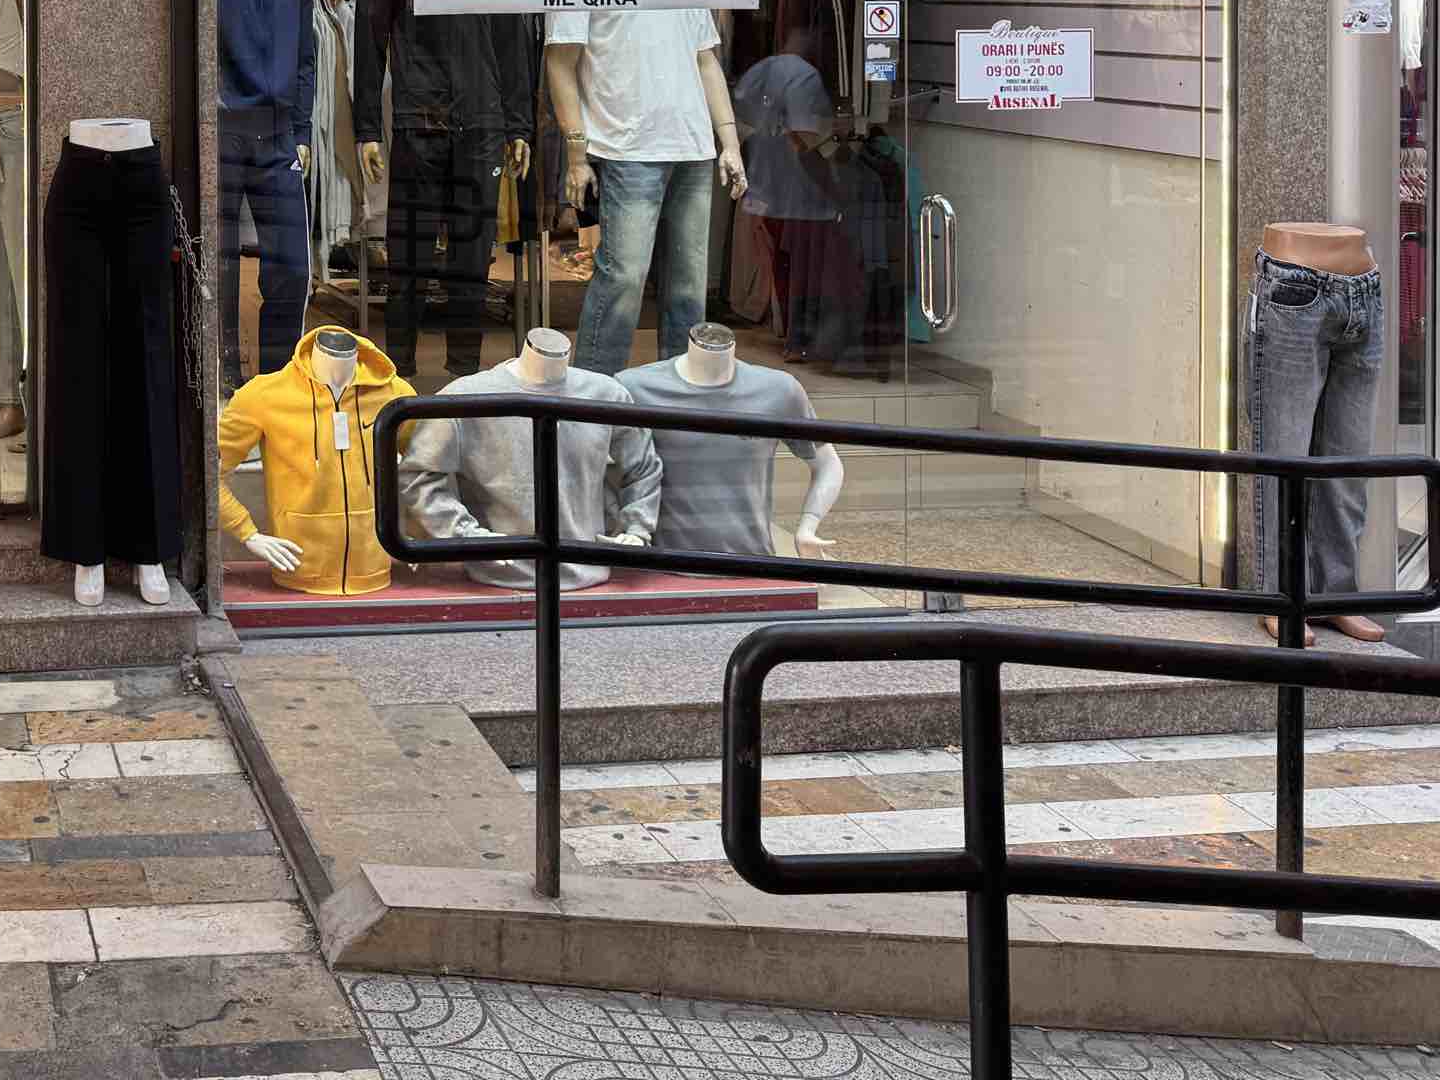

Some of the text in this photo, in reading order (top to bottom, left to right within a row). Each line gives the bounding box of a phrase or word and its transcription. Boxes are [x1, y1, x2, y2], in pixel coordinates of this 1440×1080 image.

[990, 20, 1058, 43] Boutique
[982, 44, 1017, 57] ORARI
[1027, 41, 1065, 56] PUNËS
